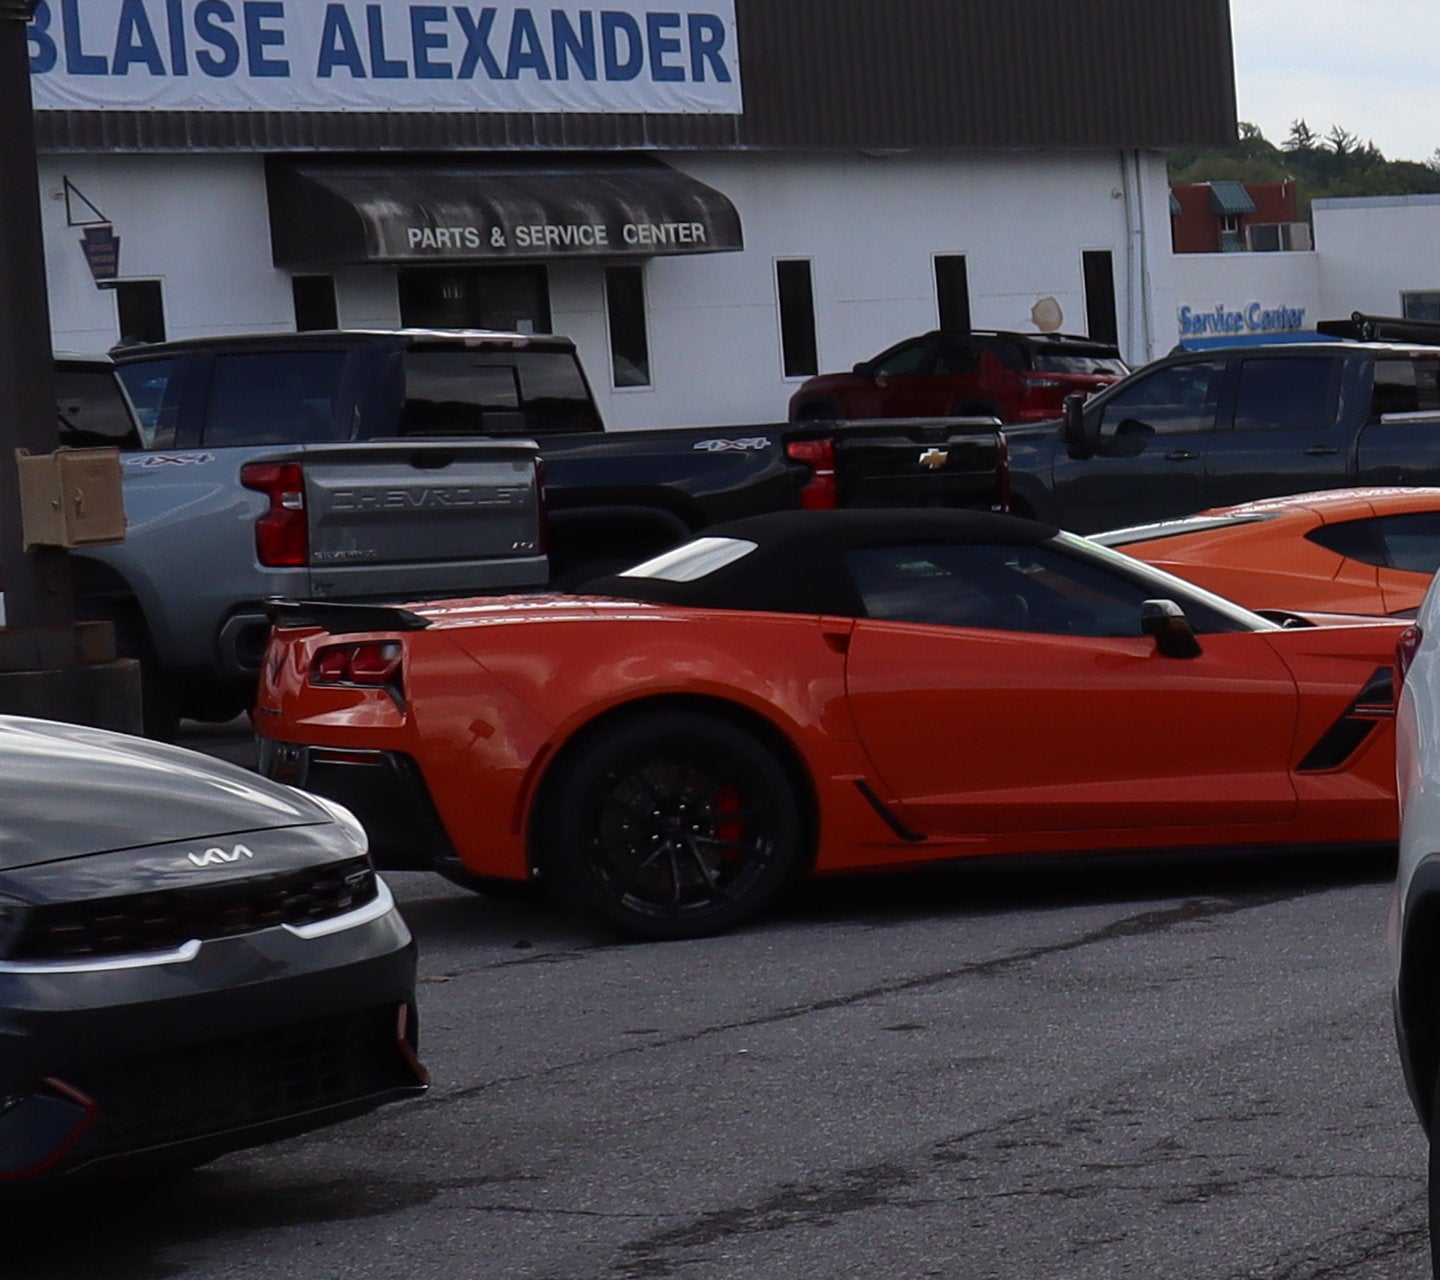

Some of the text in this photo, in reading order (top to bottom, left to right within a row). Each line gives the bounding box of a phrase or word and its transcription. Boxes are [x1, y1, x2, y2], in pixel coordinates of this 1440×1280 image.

[316, 3, 732, 82] ALEXANDER
[407, 222, 707, 248] PARTS & SERVICE CENTER
[1180, 301, 1306, 335] Service Center
[330, 488, 530, 510] CHEVROLET
